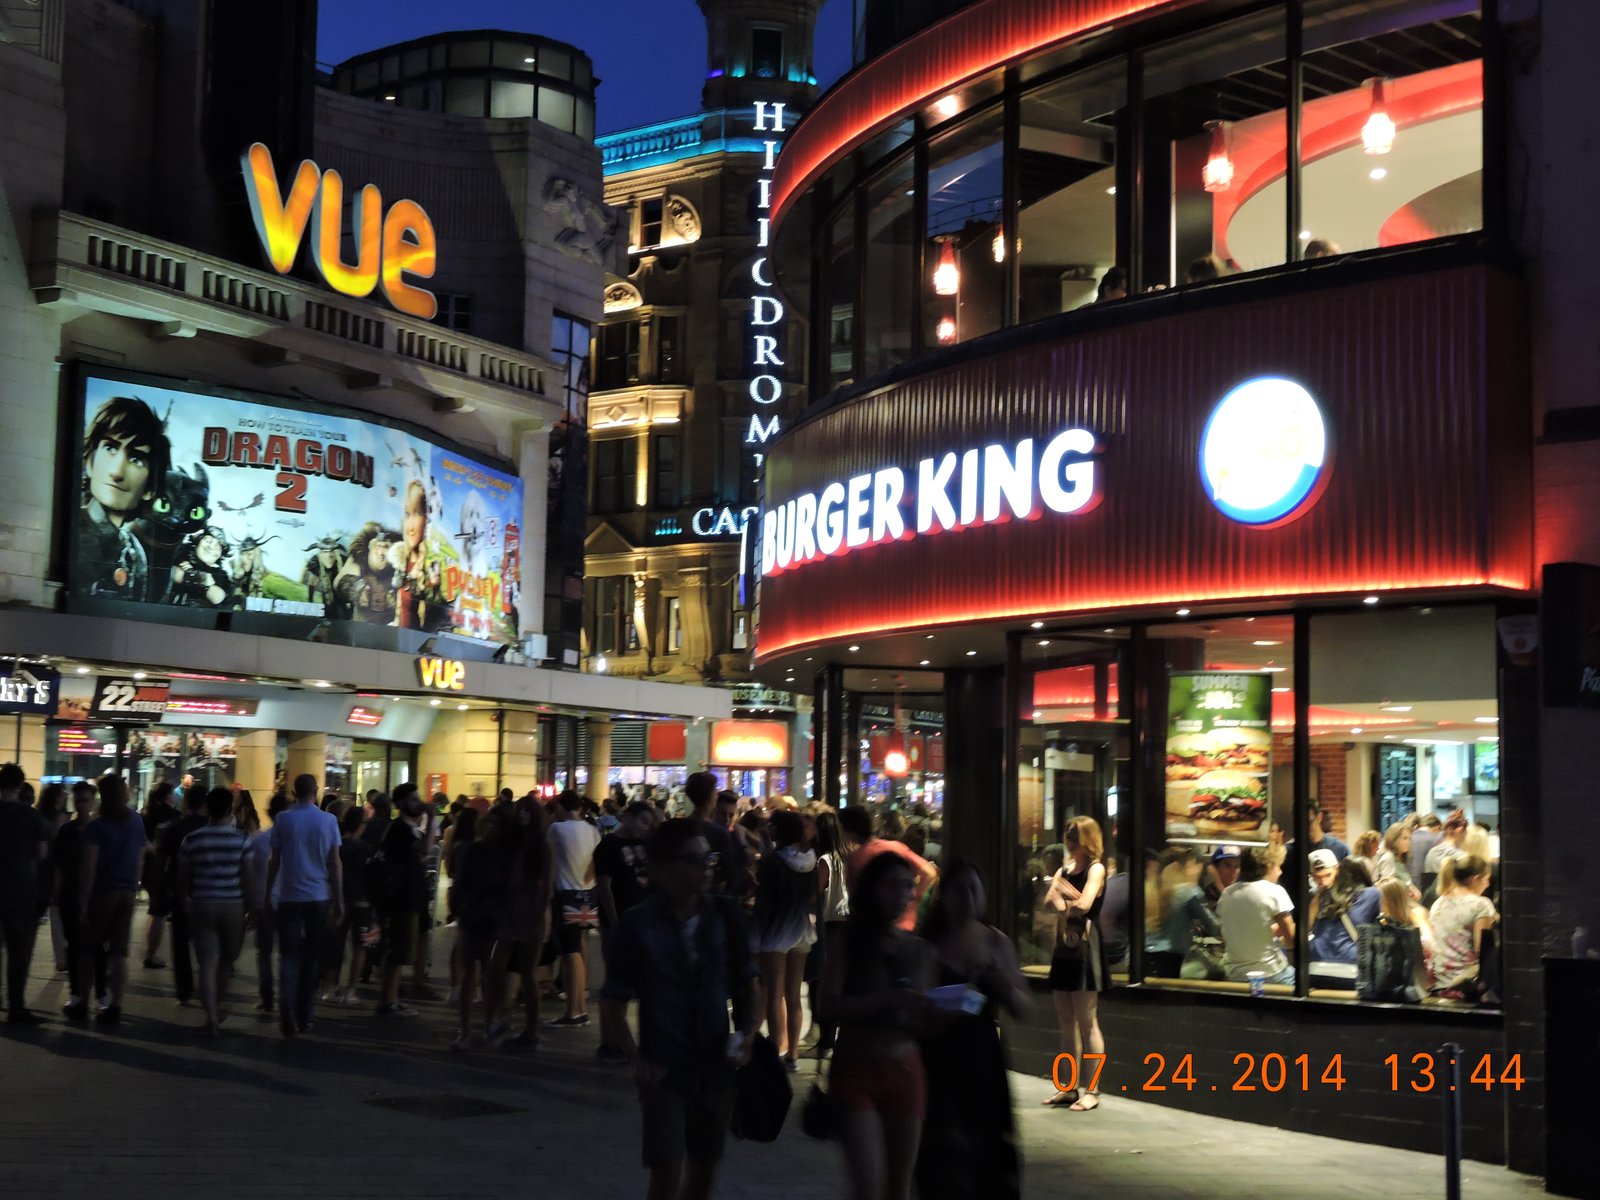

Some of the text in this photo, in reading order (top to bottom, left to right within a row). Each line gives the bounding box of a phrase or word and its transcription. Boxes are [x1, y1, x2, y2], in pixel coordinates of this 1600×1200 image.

[238, 418, 266, 430] HOW
[268, 422, 282, 432] TO
[201, 427, 375, 488] DRAGON
[275, 472, 308, 514] 2
[762, 428, 1096, 575] BURGER KING
[99, 685, 137, 712] 22
